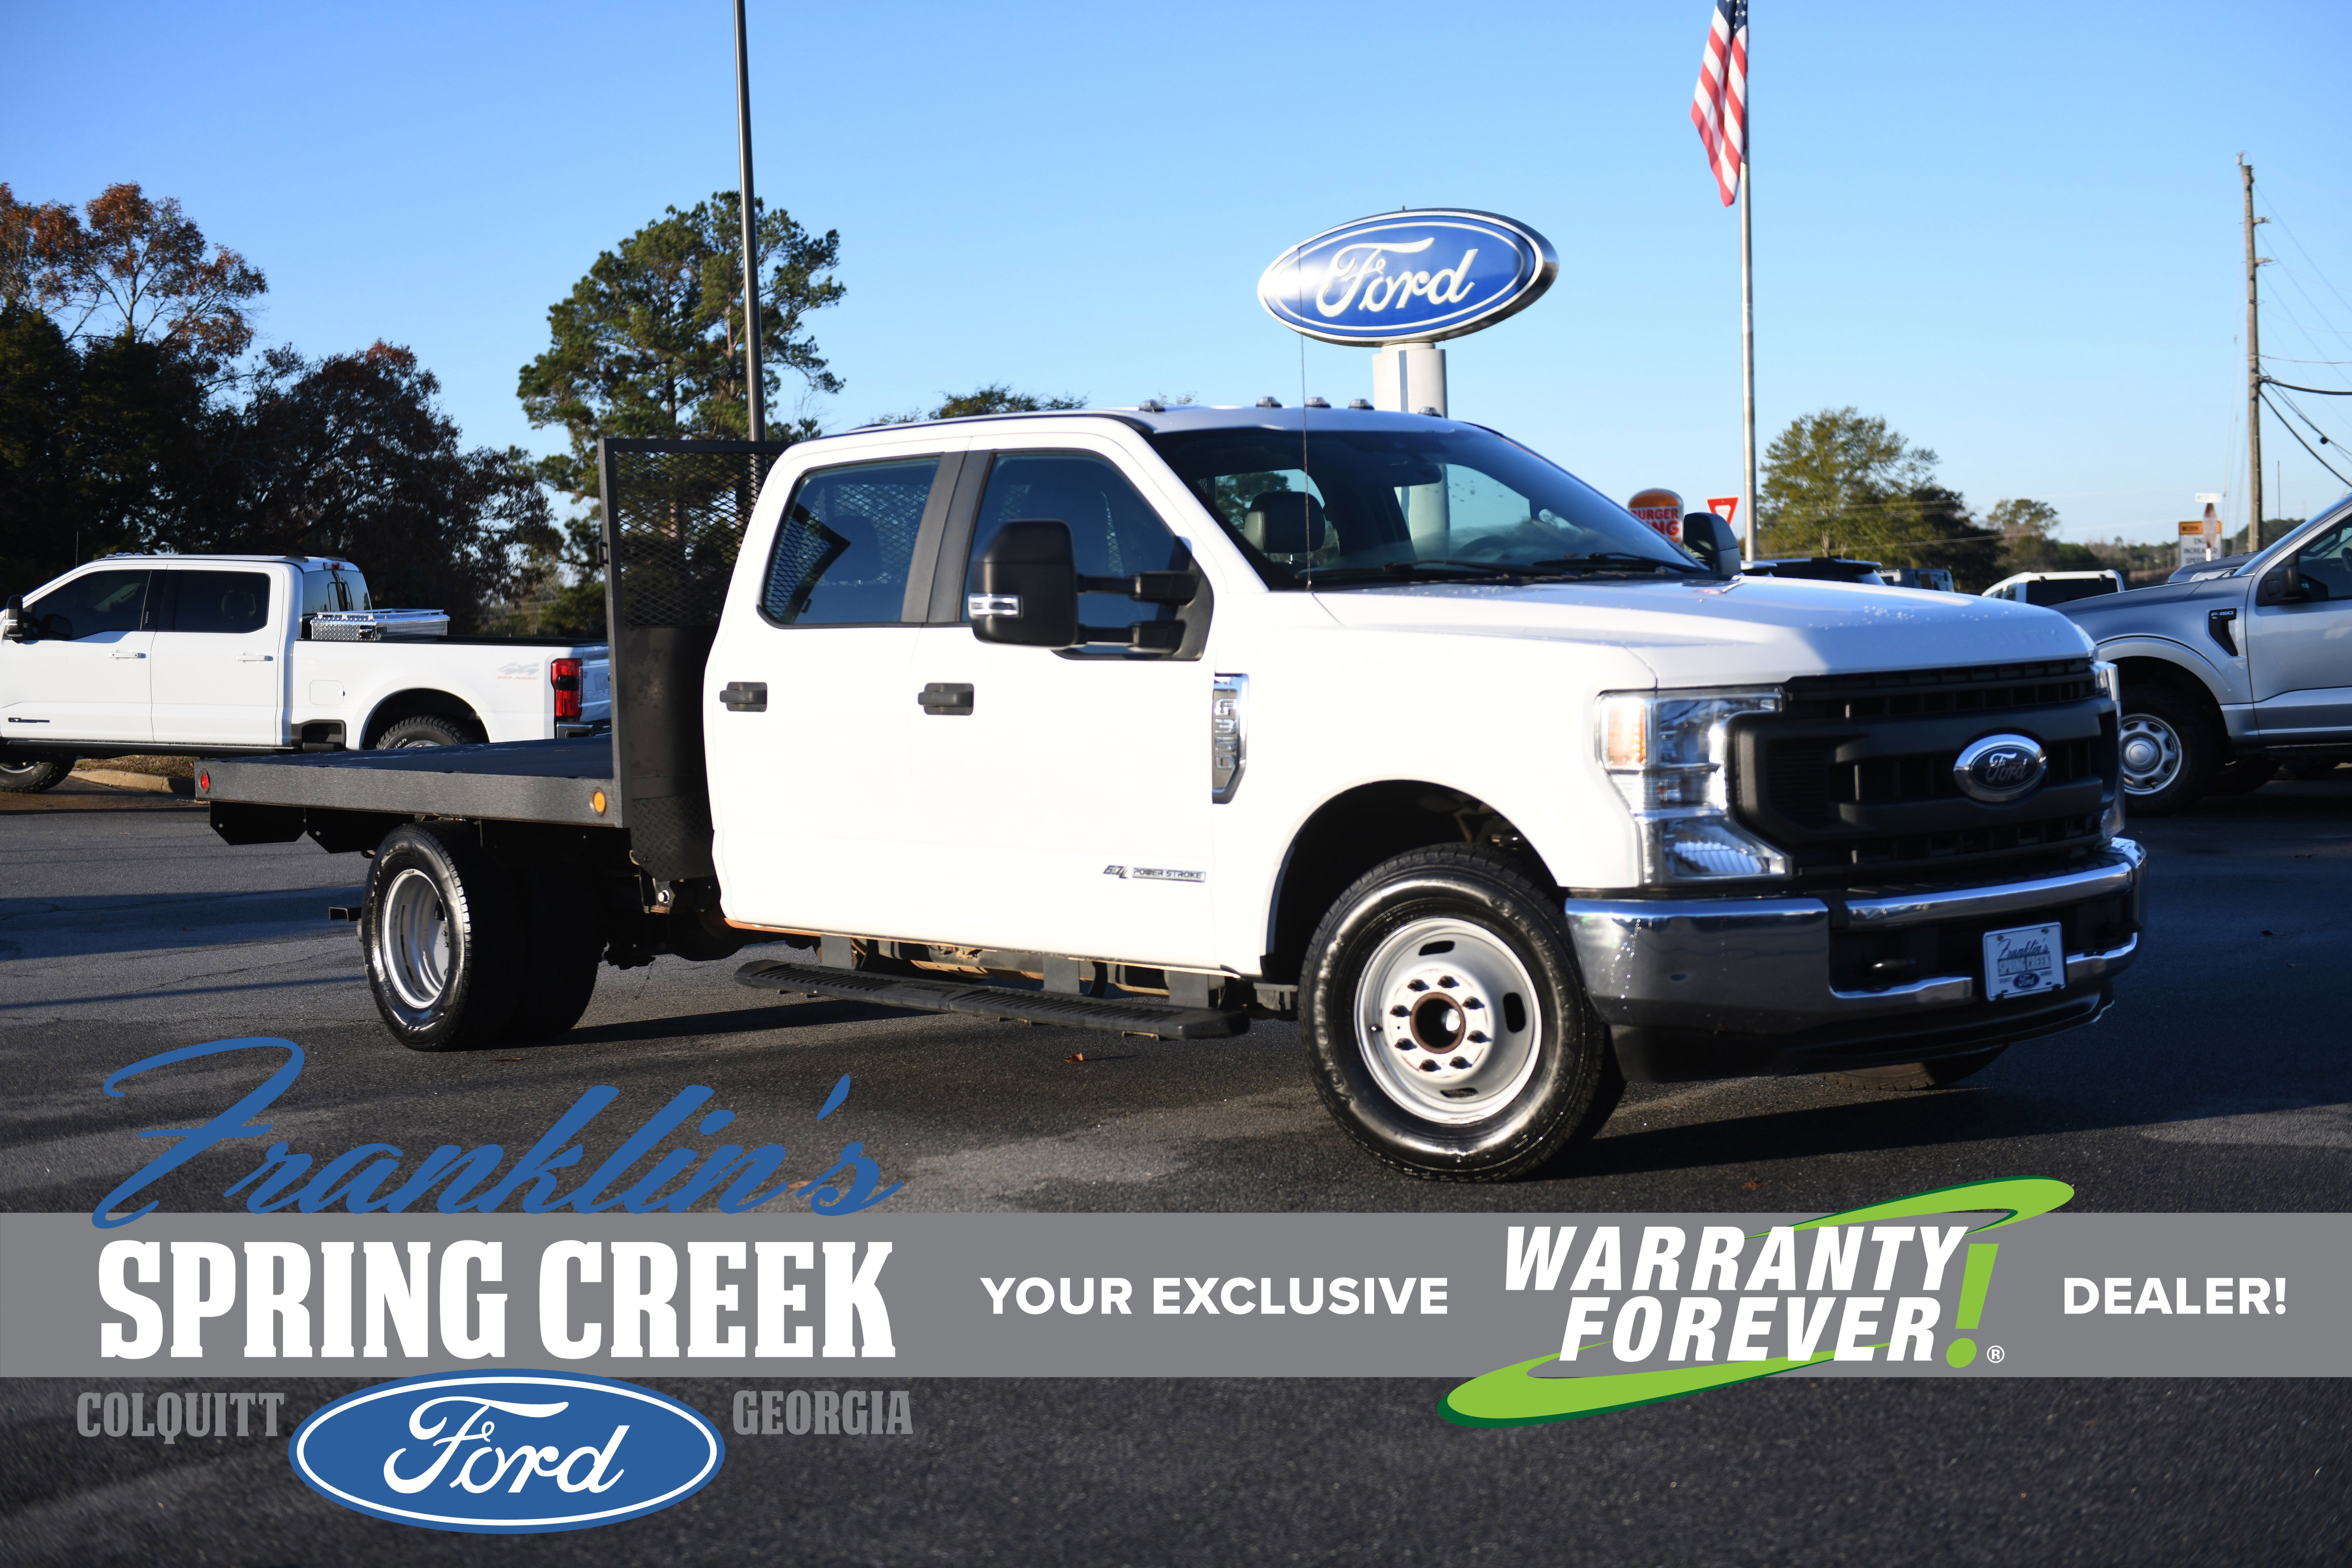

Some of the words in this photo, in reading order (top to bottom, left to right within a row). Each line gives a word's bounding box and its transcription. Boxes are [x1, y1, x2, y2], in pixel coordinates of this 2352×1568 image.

[1316, 237, 1479, 317] Ford
[586, 689, 609, 698] SUPE
[1986, 753, 2028, 783] Ford
